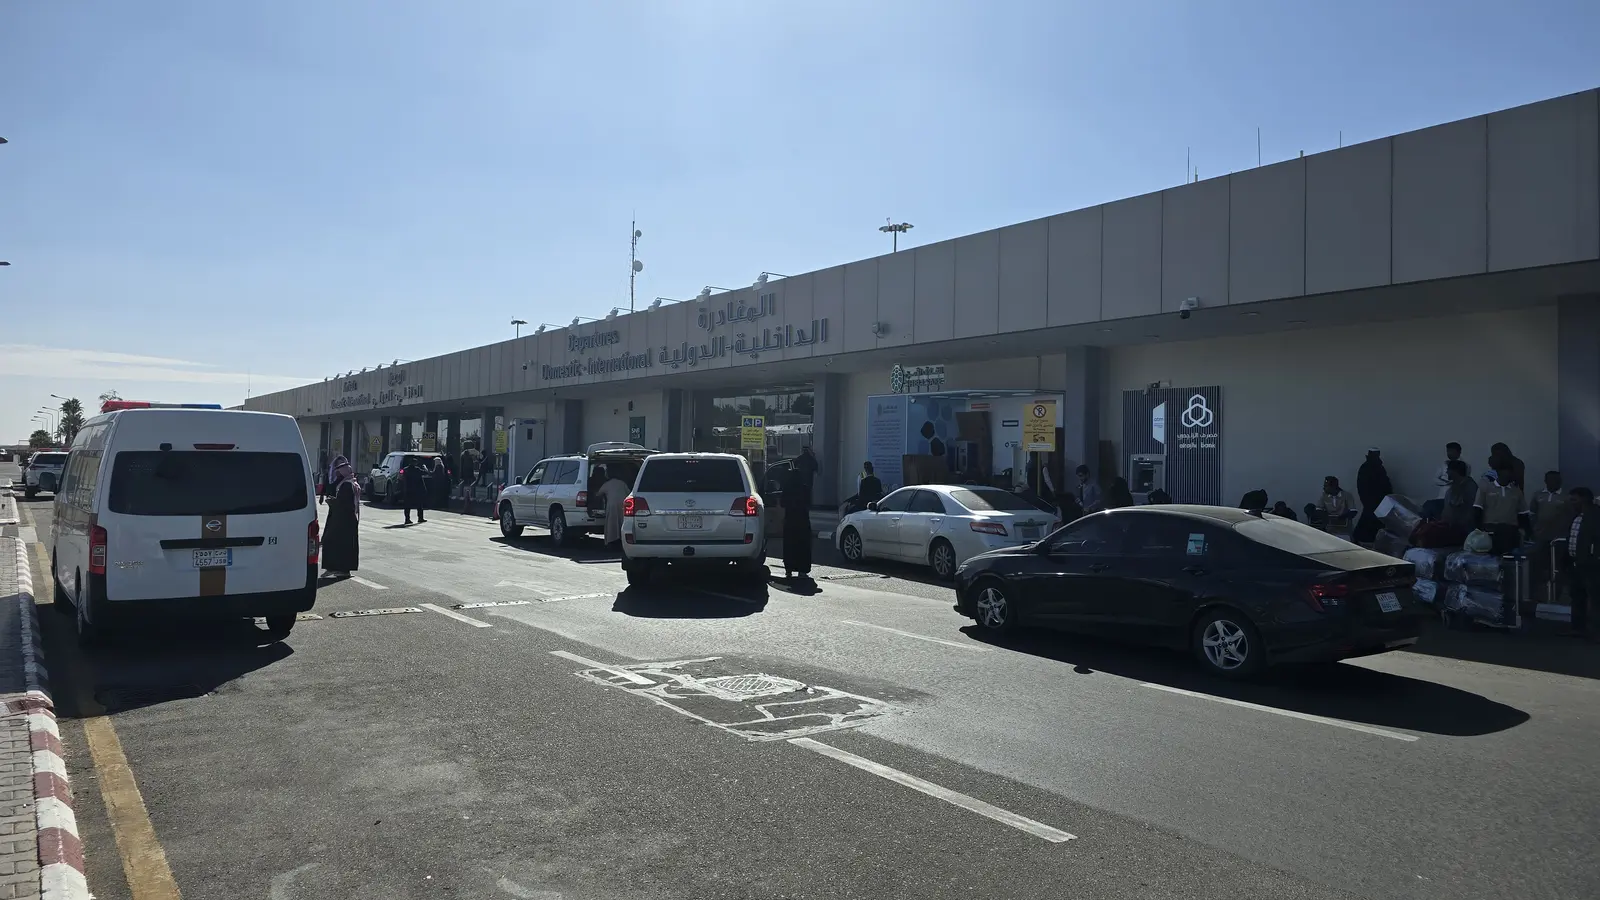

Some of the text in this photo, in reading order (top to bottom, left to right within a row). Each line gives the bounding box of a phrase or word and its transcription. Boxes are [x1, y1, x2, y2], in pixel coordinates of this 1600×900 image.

[698, 293, 775, 332] المغادرة
[568, 330, 620, 354] Departures
[542, 358, 582, 380] Domestic
[588, 347, 653, 376] International
